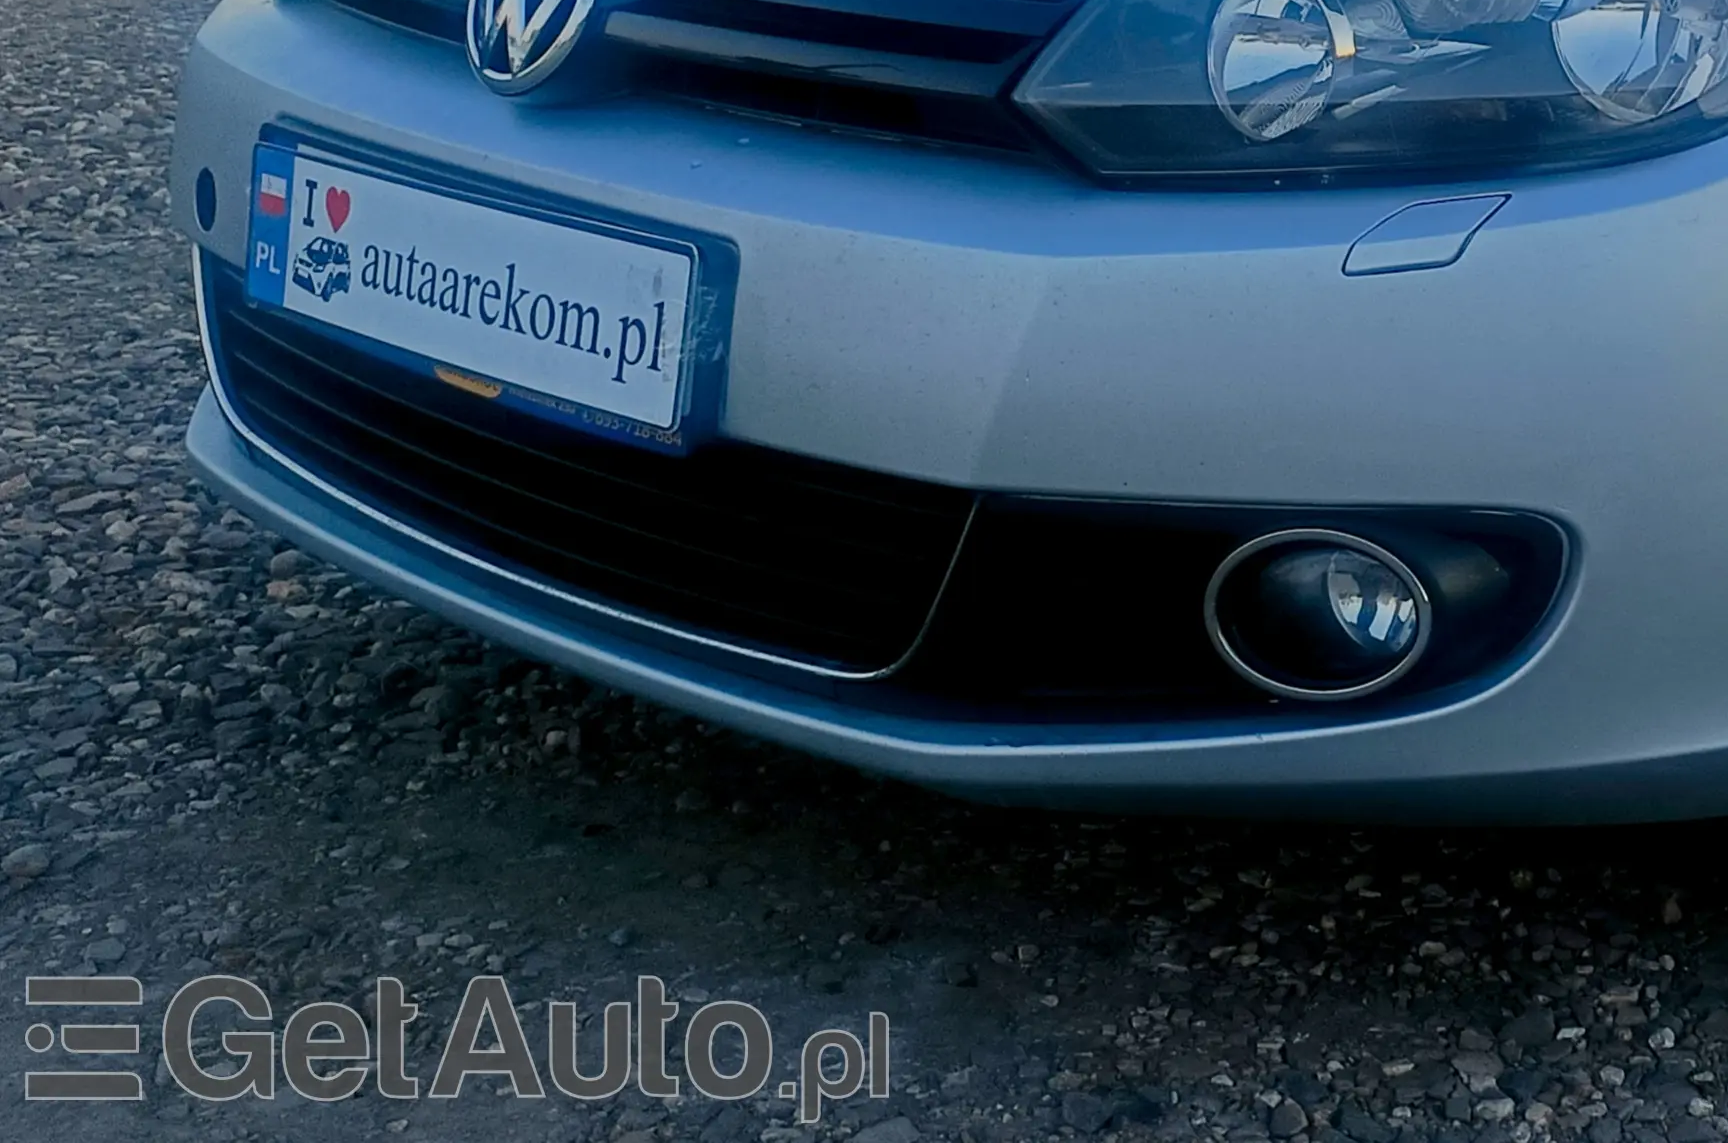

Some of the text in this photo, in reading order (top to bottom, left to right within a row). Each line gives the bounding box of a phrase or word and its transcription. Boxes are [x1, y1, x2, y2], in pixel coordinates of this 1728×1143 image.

[303, 178, 318, 228] I
[255, 241, 281, 275] PL
[361, 244, 665, 385] autaarekom.pl
